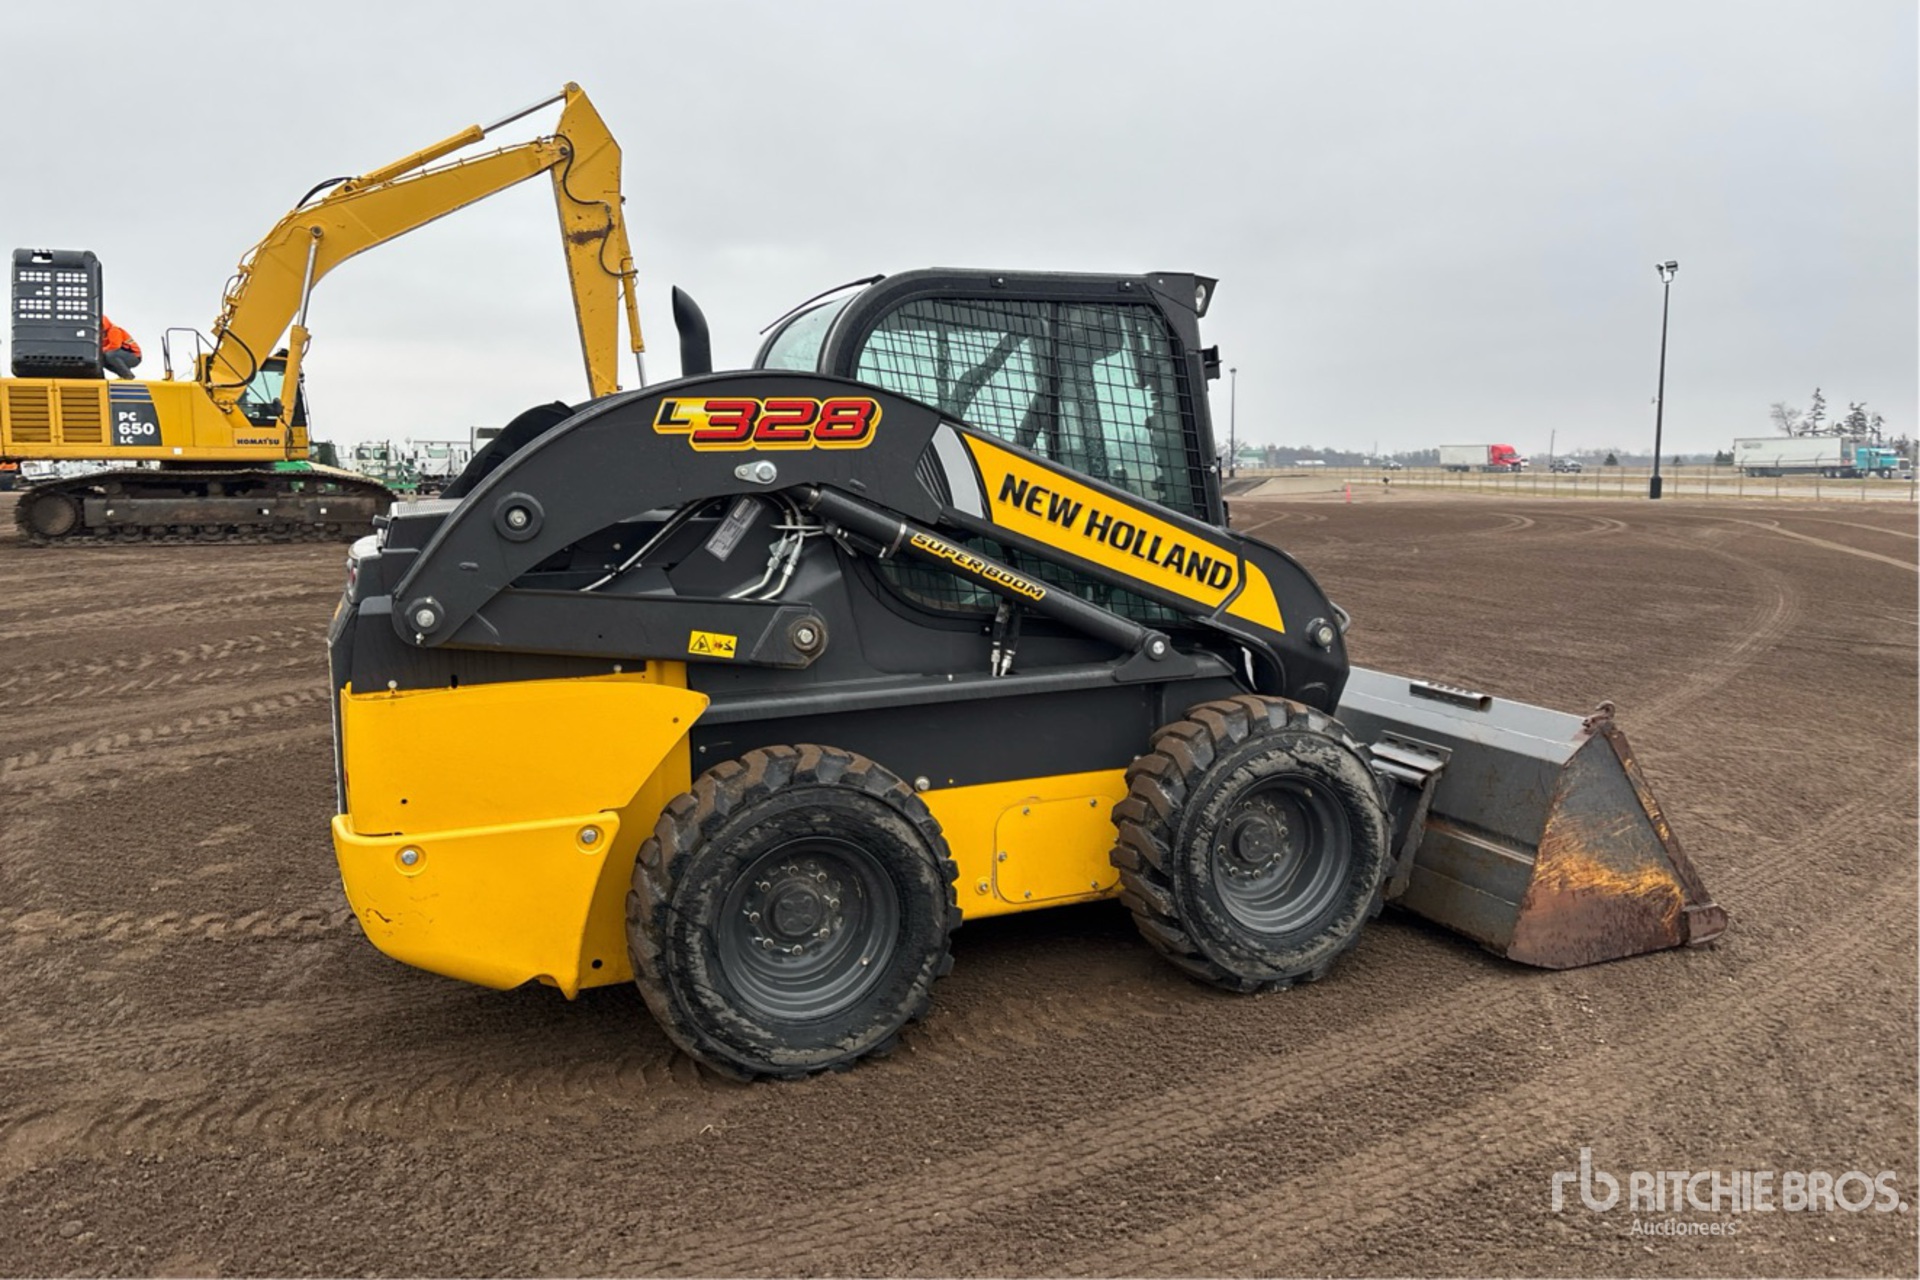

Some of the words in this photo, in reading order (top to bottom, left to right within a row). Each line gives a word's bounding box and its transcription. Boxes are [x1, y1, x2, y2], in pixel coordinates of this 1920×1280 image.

[118, 412, 137, 422] PC
[118, 422, 155, 435] 650
[120, 436, 134, 444] LC
[998, 473, 1083, 529] NEW
[1083, 509, 1234, 590] HOLLAND
